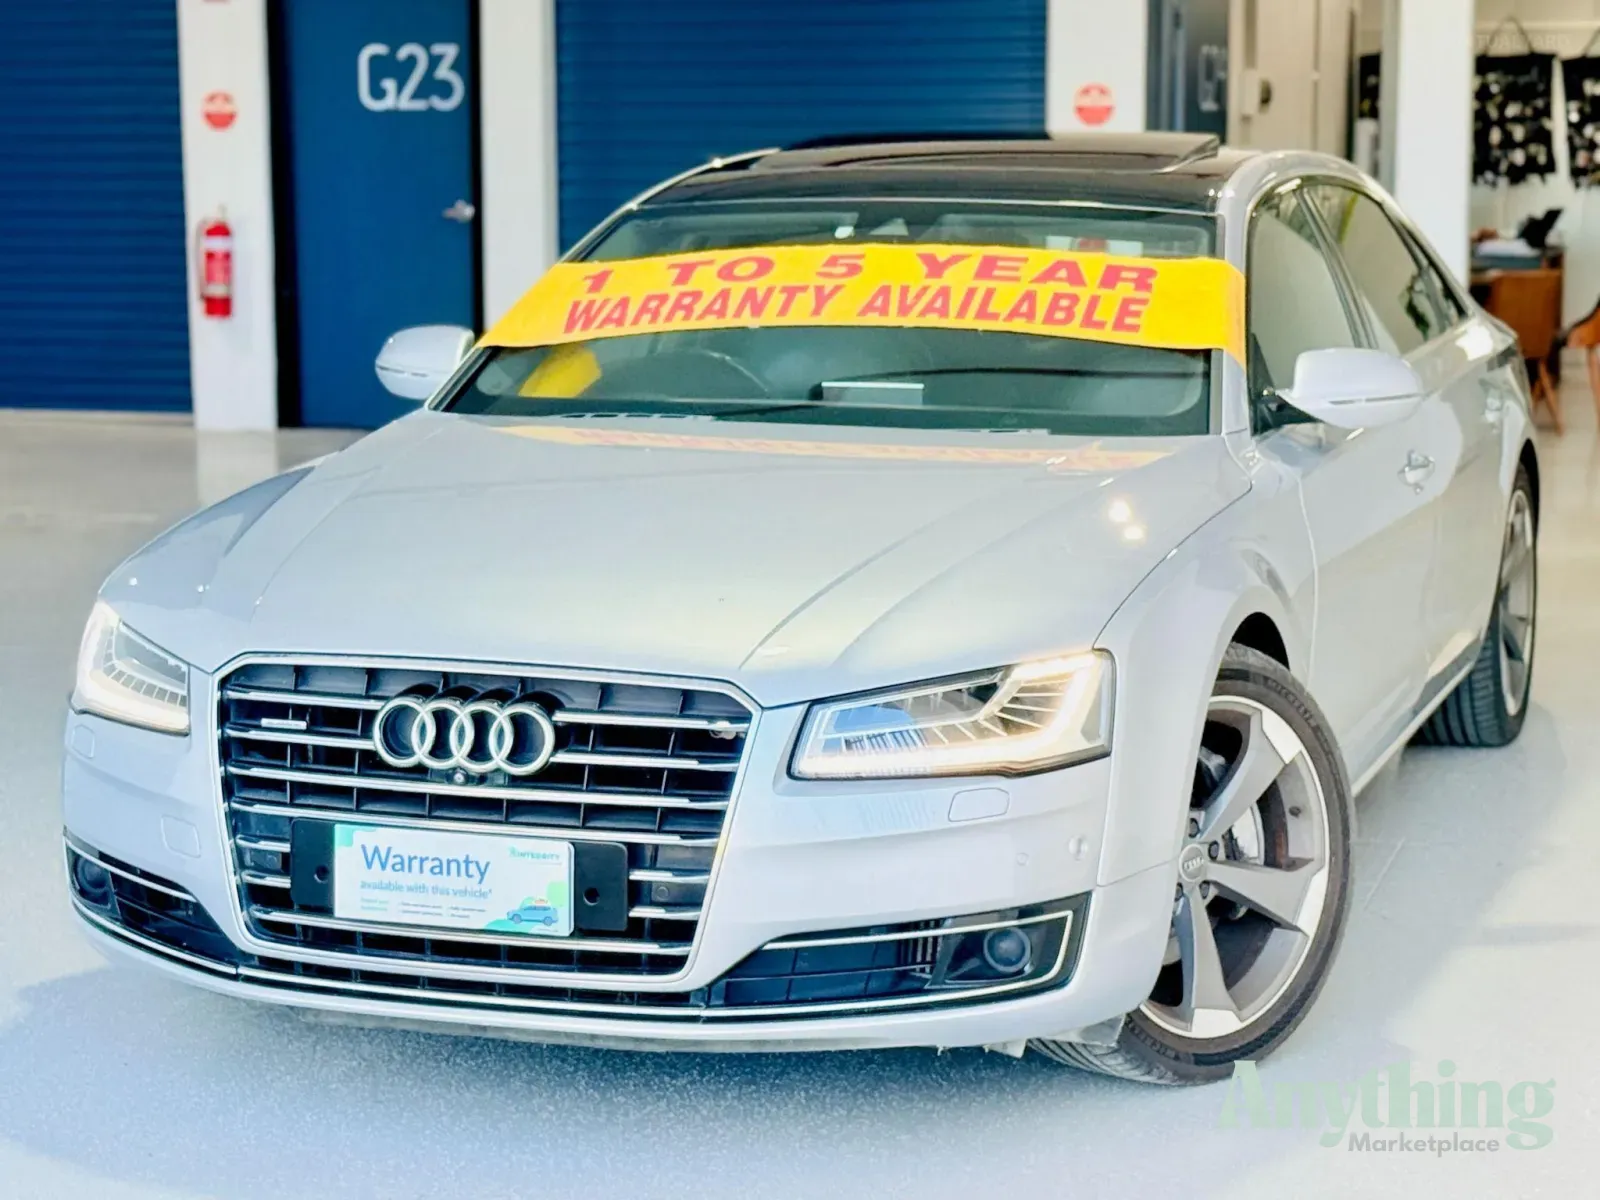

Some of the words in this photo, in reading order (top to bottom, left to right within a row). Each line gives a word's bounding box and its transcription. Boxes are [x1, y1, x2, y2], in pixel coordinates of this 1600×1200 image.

[357, 42, 465, 112] G23
[582, 269, 615, 294] 1
[666, 256, 776, 287] TO
[815, 254, 865, 280] 5
[916, 252, 1159, 293] YEAR
[563, 284, 847, 334] WARRANTY
[856, 284, 1151, 333] AVAILABLE
[361, 844, 491, 885] Warranty
[360, 879, 405, 892] available
[406, 883, 428, 895] with
[431, 884, 450, 896] this
